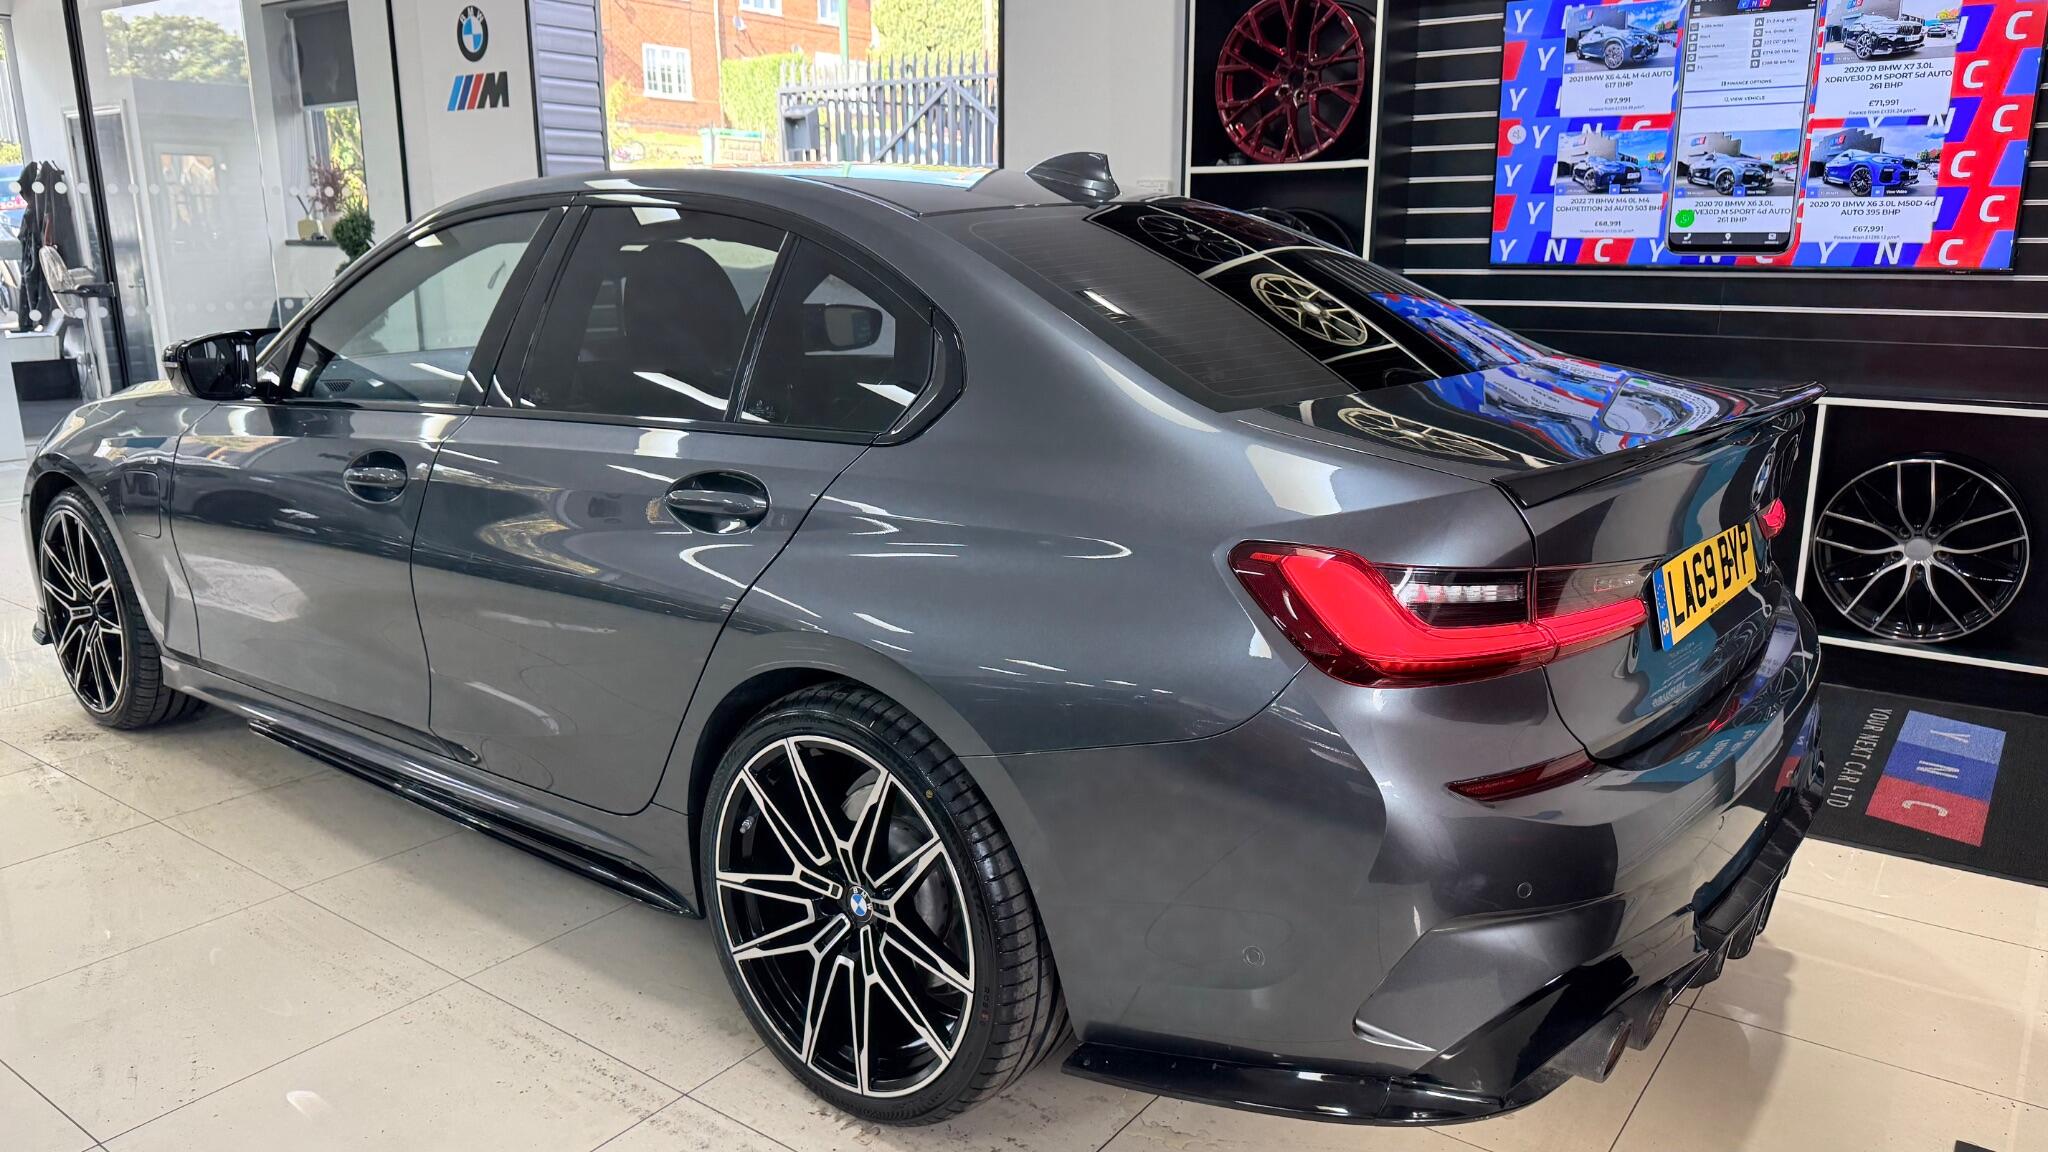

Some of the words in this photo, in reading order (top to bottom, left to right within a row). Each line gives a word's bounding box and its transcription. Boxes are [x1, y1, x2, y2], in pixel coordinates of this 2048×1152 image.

[1844, 66, 1864, 74] 2020
[1866, 65, 1877, 73] 70
[1878, 64, 1902, 72] BMW
[1916, 62, 1934, 70] 3.0L
[1568, 75, 1584, 83] 2021
[1585, 74, 1604, 82] BMW
[1652, 70, 1673, 78] AUTO
[1825, 73, 1872, 83] XDRIVE30D
[1884, 72, 1913, 80] SPORT
[1915, 70, 1926, 78] 5d
[1927, 69, 1952, 78] AUTO
[1869, 82, 1883, 90] 261
[1884, 81, 1903, 89] BHP
[1604, 97, 1631, 105] £97,991
[1869, 99, 1899, 107] £71,991
[1866, 208, 1881, 216] 395
[1853, 225, 1884, 233] £67,991
[1667, 544, 1718, 628] LA69
[1717, 523, 1749, 590] BYP
[1863, 707, 1893, 732] YOUR
[1850, 733, 1881, 760] NEXT
[1837, 761, 1867, 783] CAR
[1826, 785, 1856, 809] LTD
